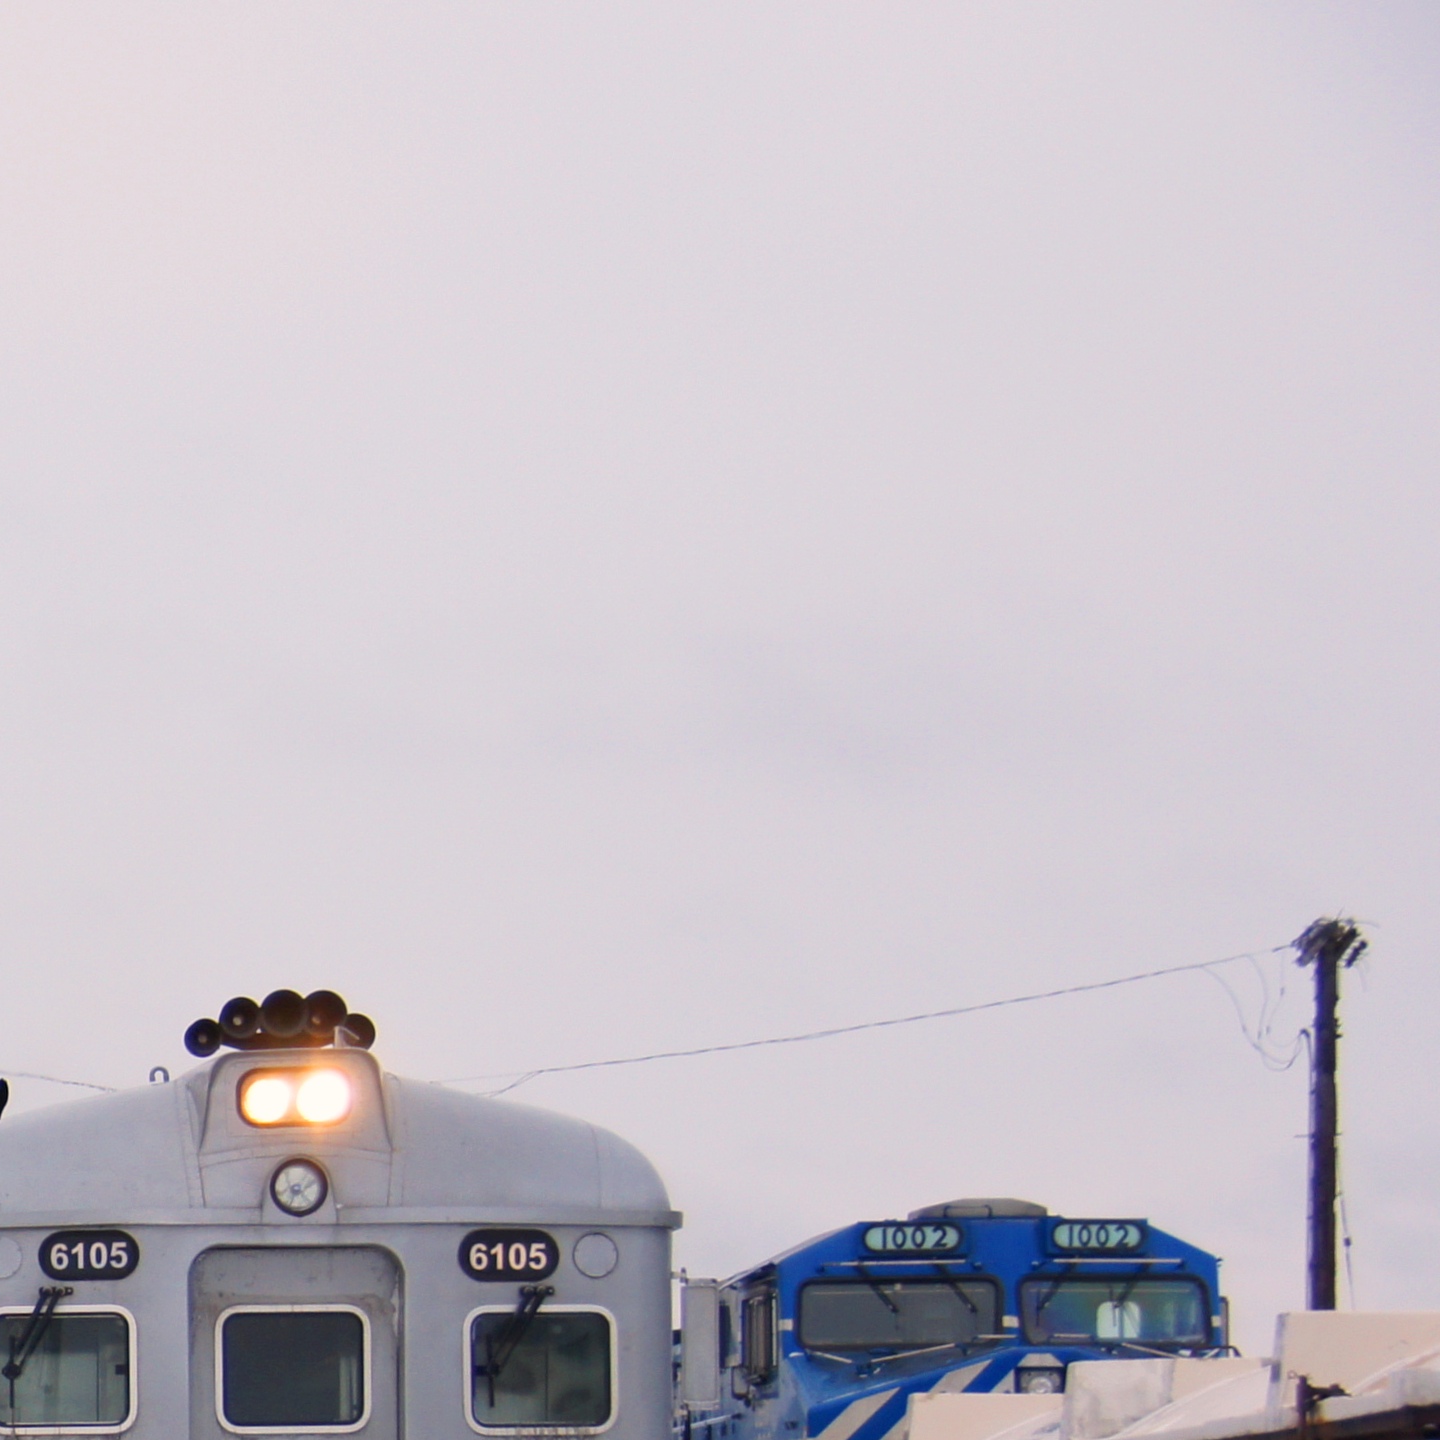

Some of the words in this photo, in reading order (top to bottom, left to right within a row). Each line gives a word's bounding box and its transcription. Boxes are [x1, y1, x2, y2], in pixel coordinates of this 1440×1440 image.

[882, 1226, 948, 1249] 1002
[1068, 1224, 1130, 1248] 1002
[50, 1242, 128, 1270] 6105
[469, 1242, 547, 1270] 6105
